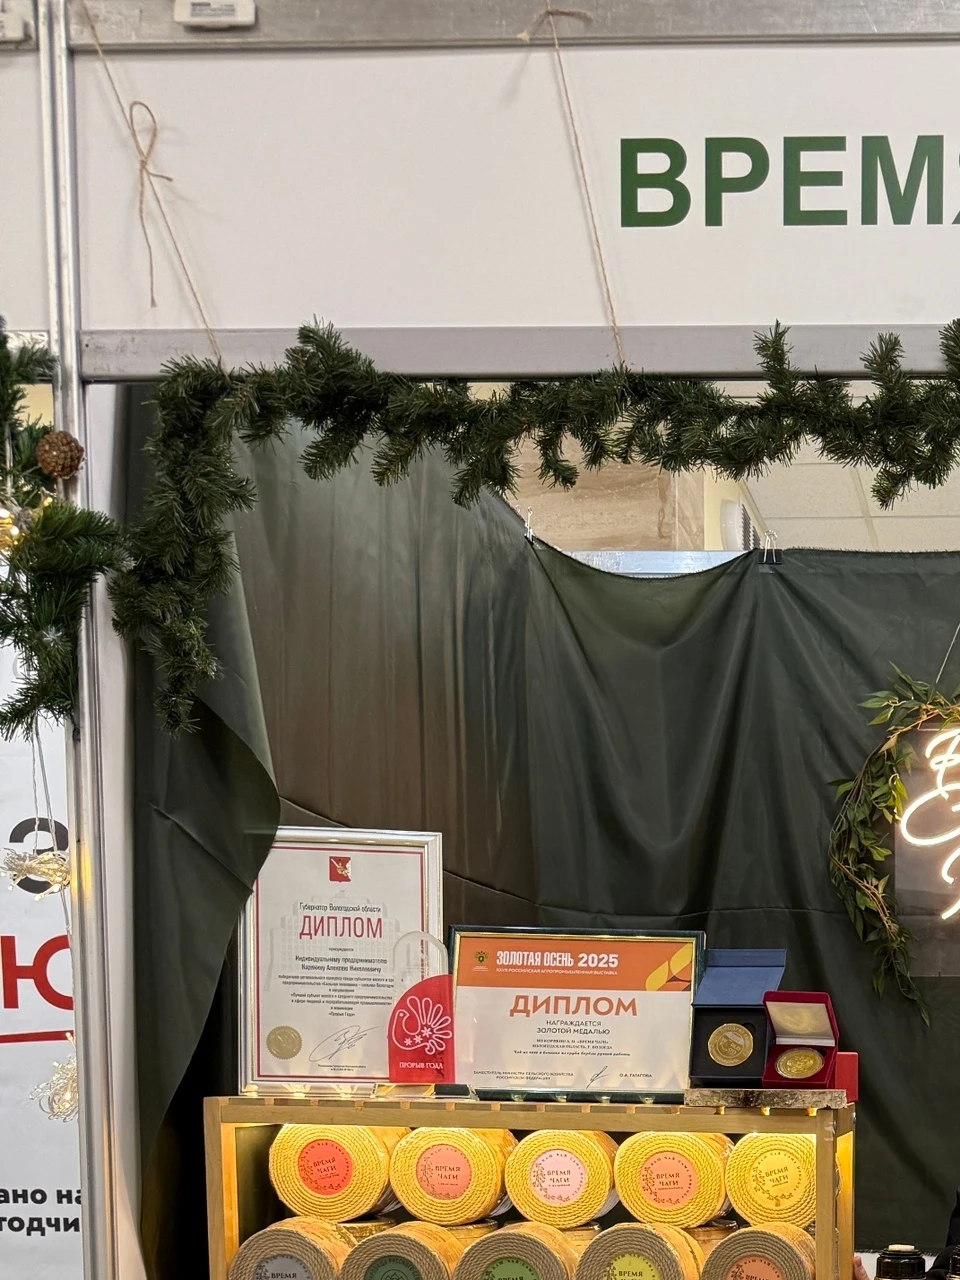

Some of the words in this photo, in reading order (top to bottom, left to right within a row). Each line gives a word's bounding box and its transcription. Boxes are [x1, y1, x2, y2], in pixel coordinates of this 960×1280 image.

[329, 903, 360, 912] Вологодской
[362, 904, 381, 912] области
[299, 915, 382, 940] ДИПЛОМ
[295, 955, 340, 964] Индивидуальному
[496, 951, 541, 966] ЗОЛОТАЯ
[544, 952, 574, 967] ОСЕНЬ
[578, 953, 618, 968] 2025
[510, 995, 637, 1017] ДИПЛОМ
[313, 1157, 336, 1167] ВРЕМЯ
[317, 1165, 337, 1174] ЧАГИ
[765, 1167, 788, 1177] ВРЕМЯ
[770, 1175, 788, 1183] ЧАГИ
